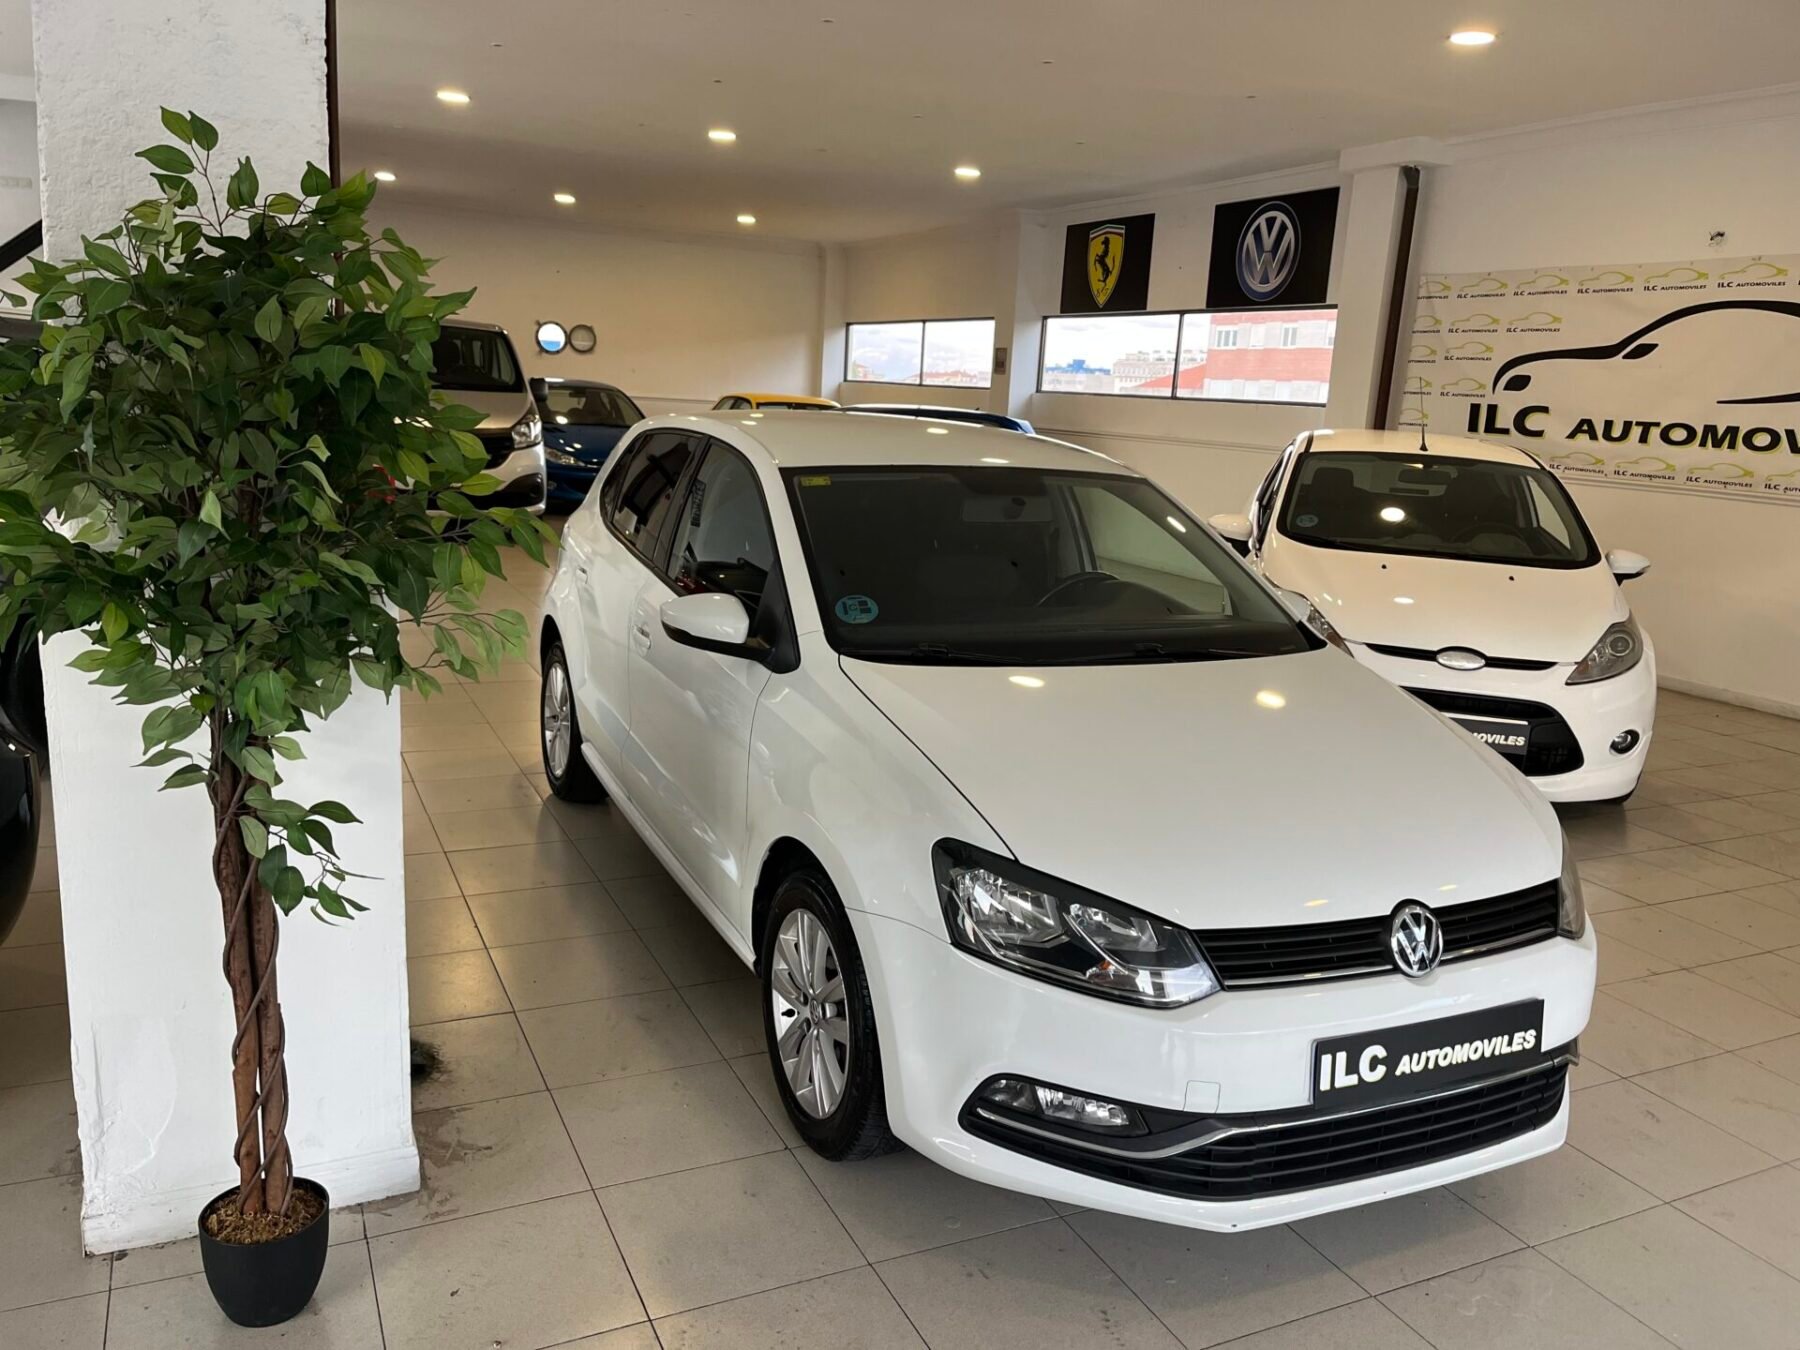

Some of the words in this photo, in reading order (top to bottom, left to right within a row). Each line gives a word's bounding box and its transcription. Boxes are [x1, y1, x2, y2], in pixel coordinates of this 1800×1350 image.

[1643, 284, 1658, 292] ILC
[1717, 281, 1733, 289] ILC
[1466, 402, 1550, 439] ILC
[1613, 469, 1628, 477] ILC
[1629, 472, 1676, 481] AUTOMOVILES
[1685, 475, 1701, 484] ILC
[1703, 479, 1753, 489] AUTOMOVILES
[1764, 483, 1781, 491] ILC
[1319, 1044, 1388, 1091] ILC
[1394, 1029, 1537, 1077] AUTOMOVILES
